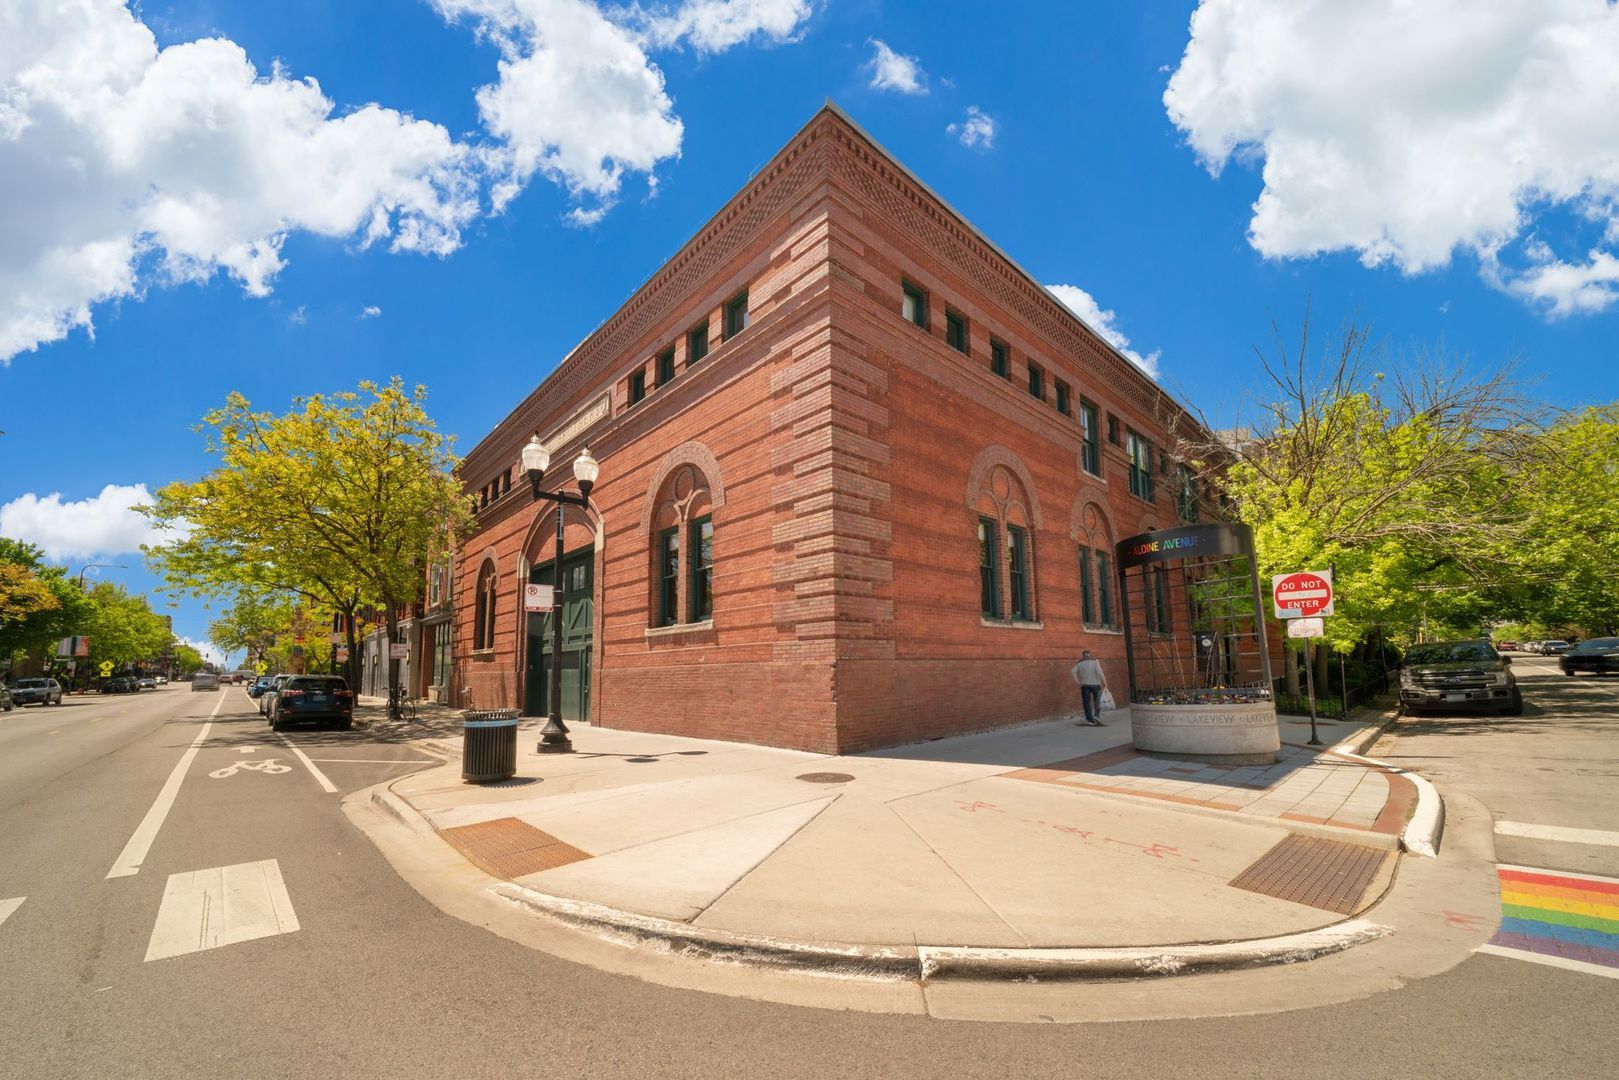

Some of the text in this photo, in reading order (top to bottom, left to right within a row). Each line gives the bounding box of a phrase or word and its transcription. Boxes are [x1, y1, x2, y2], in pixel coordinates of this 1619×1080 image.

[1162, 535, 1198, 551] AVENUE
[1281, 580, 1321, 591] DO NOT
[1287, 600, 1319, 609] ENTER
[1187, 714, 1234, 725] LAKEVIEW
